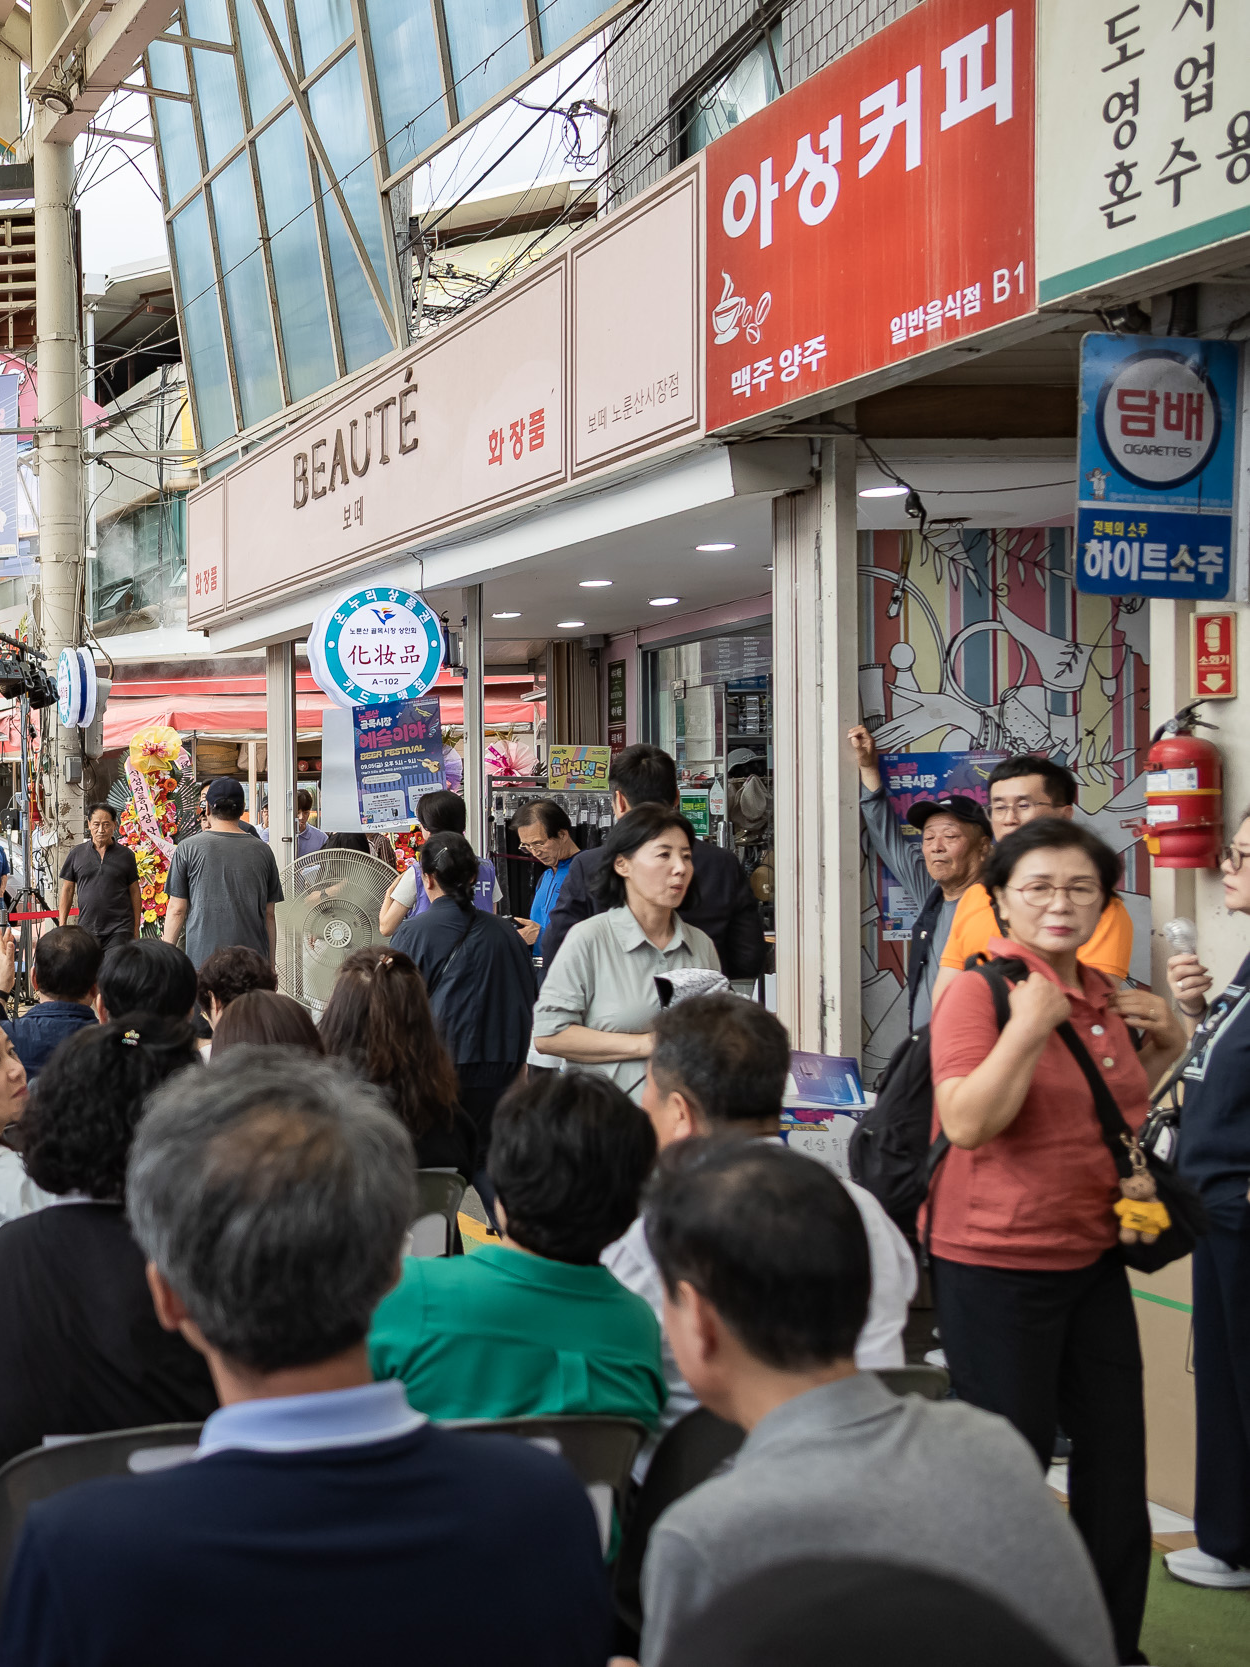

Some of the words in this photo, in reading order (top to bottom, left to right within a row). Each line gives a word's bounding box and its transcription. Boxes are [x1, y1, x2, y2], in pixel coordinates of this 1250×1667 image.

[890, 282, 982, 346] 일반음식점
[993, 261, 1026, 305] B1
[730, 355, 775, 399] 맥주
[778, 334, 828, 384] 양주
[587, 407, 608, 436] 보떼
[612, 370, 680, 427] 노룬산시장점
[1116, 388, 1204, 442] 담배
[292, 367, 419, 510] BEAUTÉ
[488, 408, 546, 467] 화장품
[1123, 443, 1193, 458] CIGARETTES
[341, 495, 365, 530] 보떼
[1093, 519, 1124, 536] 전북의
[1127, 521, 1148, 538] 소주
[1084, 538, 1224, 585] 하이트소주
[194, 565, 218, 597] 화장품
[349, 627, 369, 635] 노룬산
[370, 627, 396, 635] 골목시장
[348, 643, 420, 666] 化妆品
[1197, 654, 1230, 666] 소화기
[371, 678, 399, 686] A-102
[359, 721, 426, 749] 예술이야
[360, 716, 392, 730] 골목시장
[359, 750, 382, 760] BEER
[384, 744, 426, 758] FESTIVAL
[889, 773, 938, 789] 골목시장
